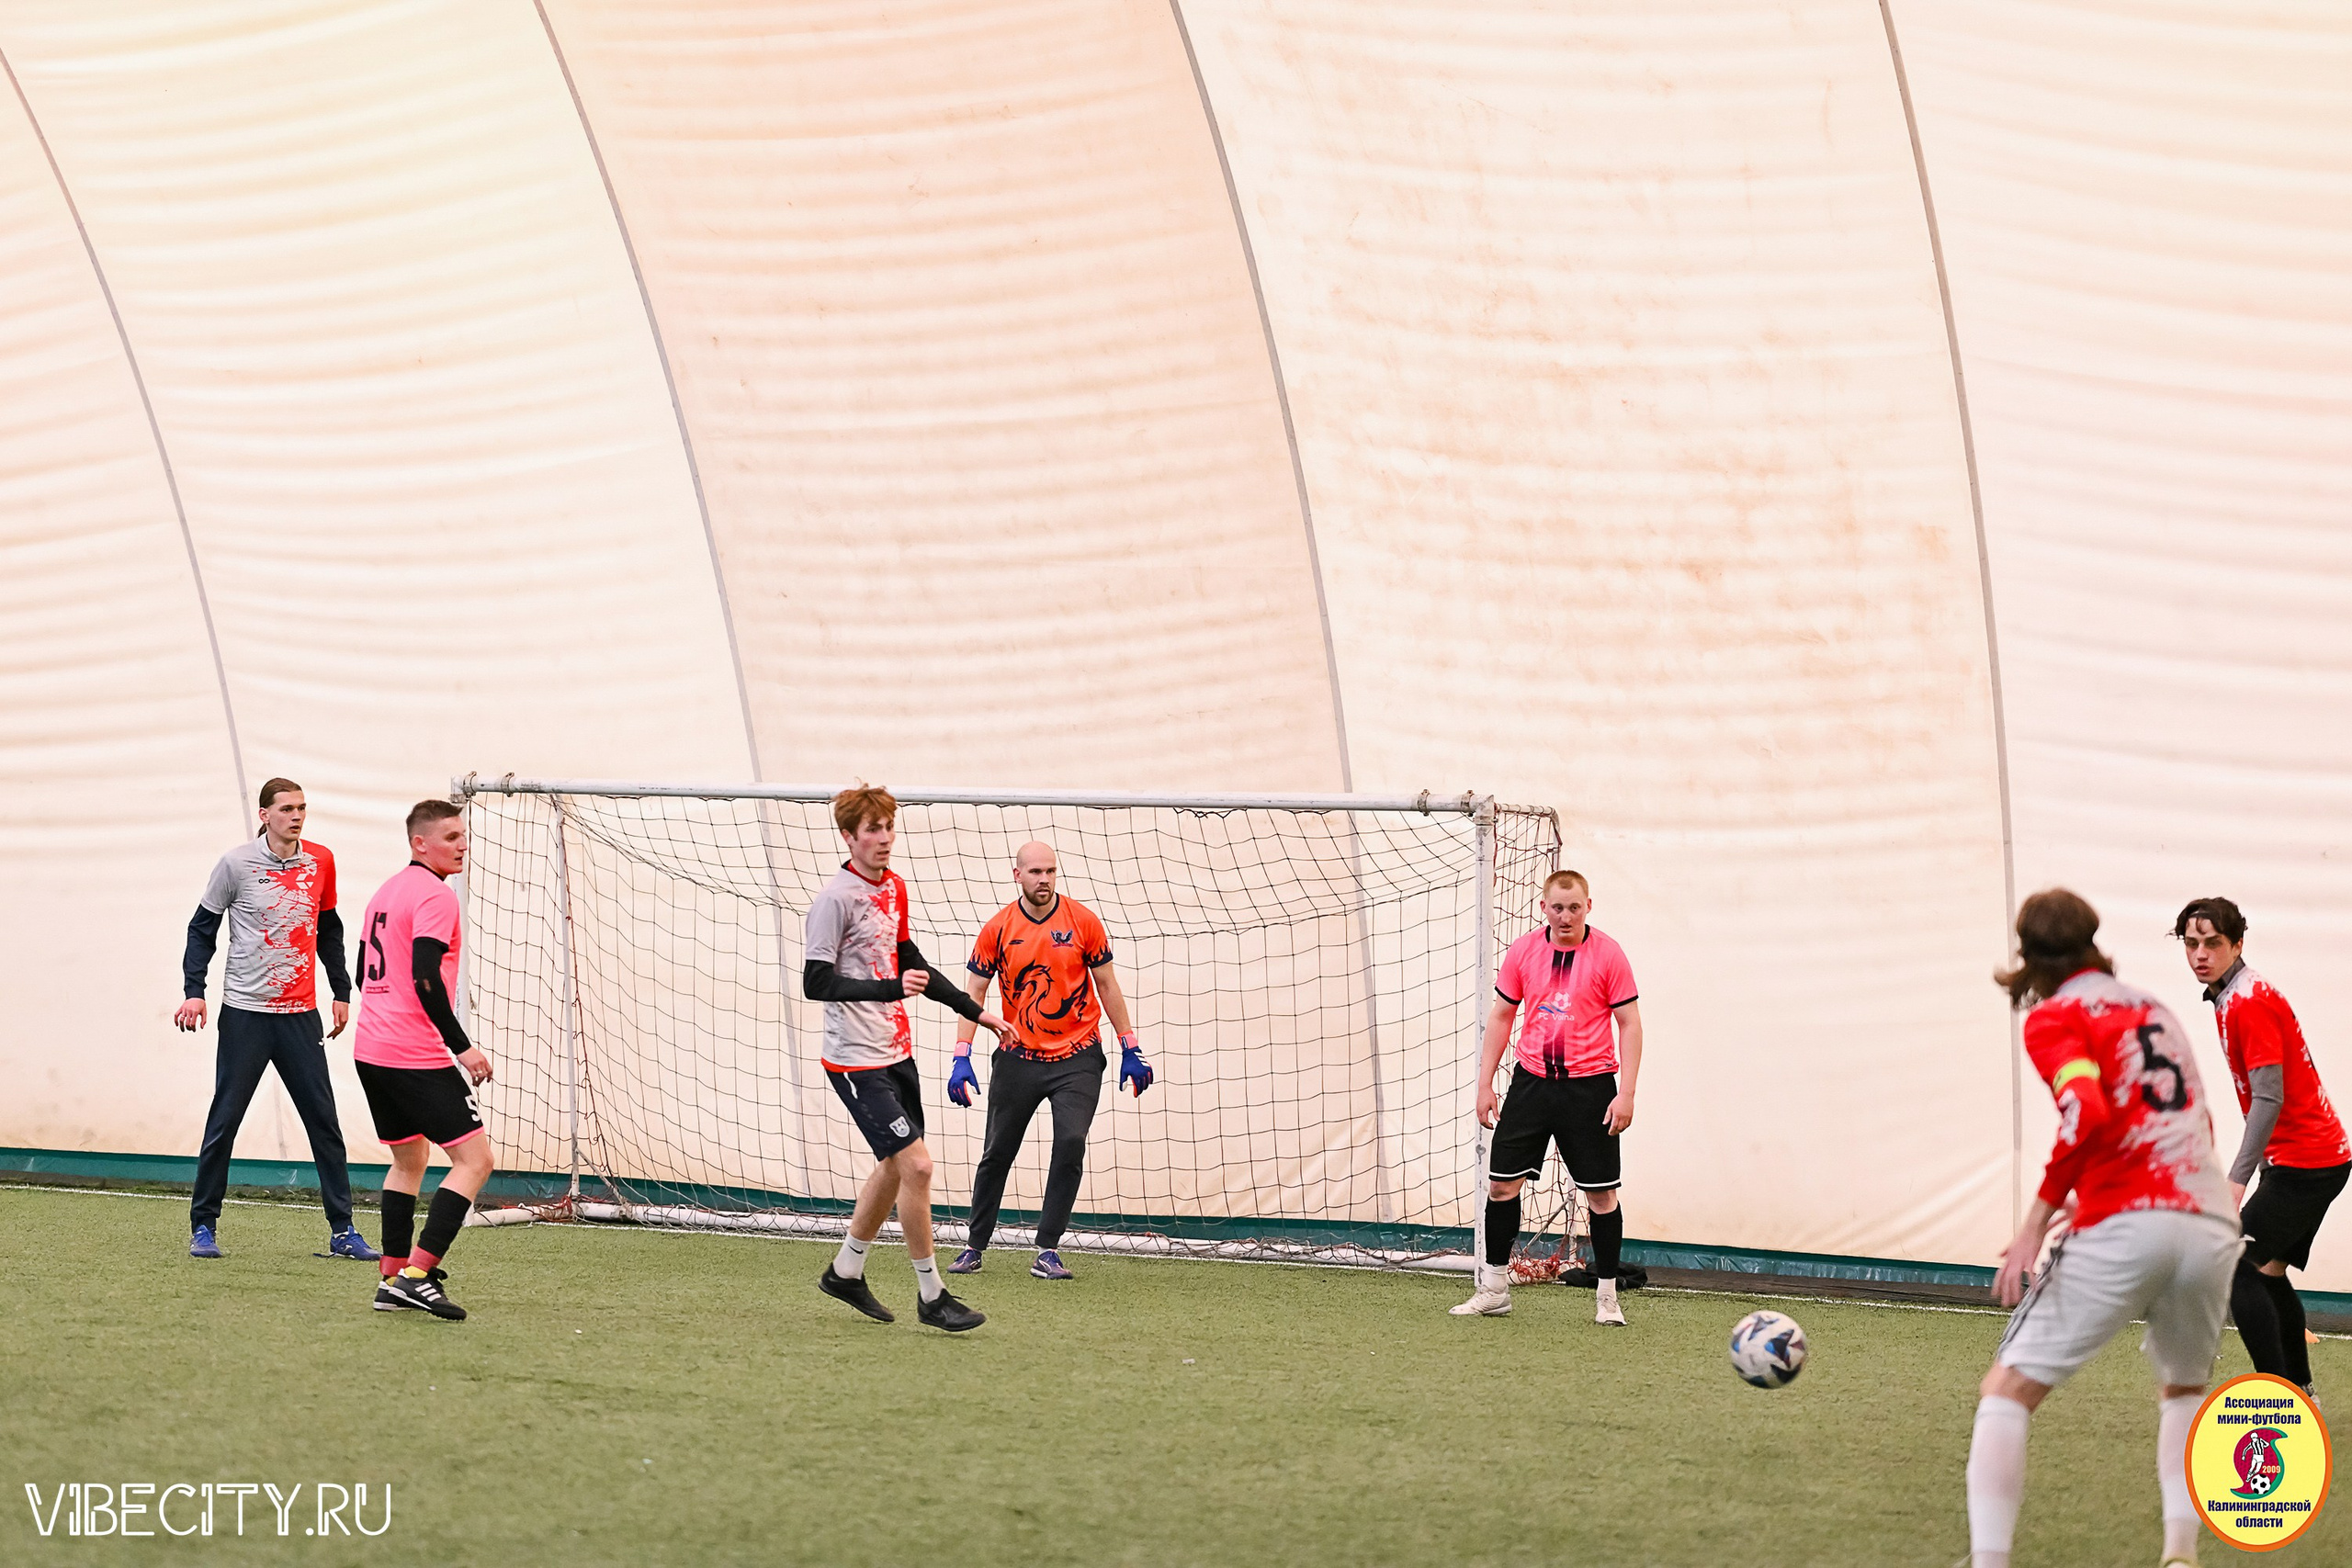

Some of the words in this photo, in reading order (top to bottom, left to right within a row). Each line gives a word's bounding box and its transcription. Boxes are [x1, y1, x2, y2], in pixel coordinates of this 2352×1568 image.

[1538, 1012, 1549, 1021] FC
[1553, 1013, 1575, 1021] Volna
[2138, 1023, 2187, 1112] 5
